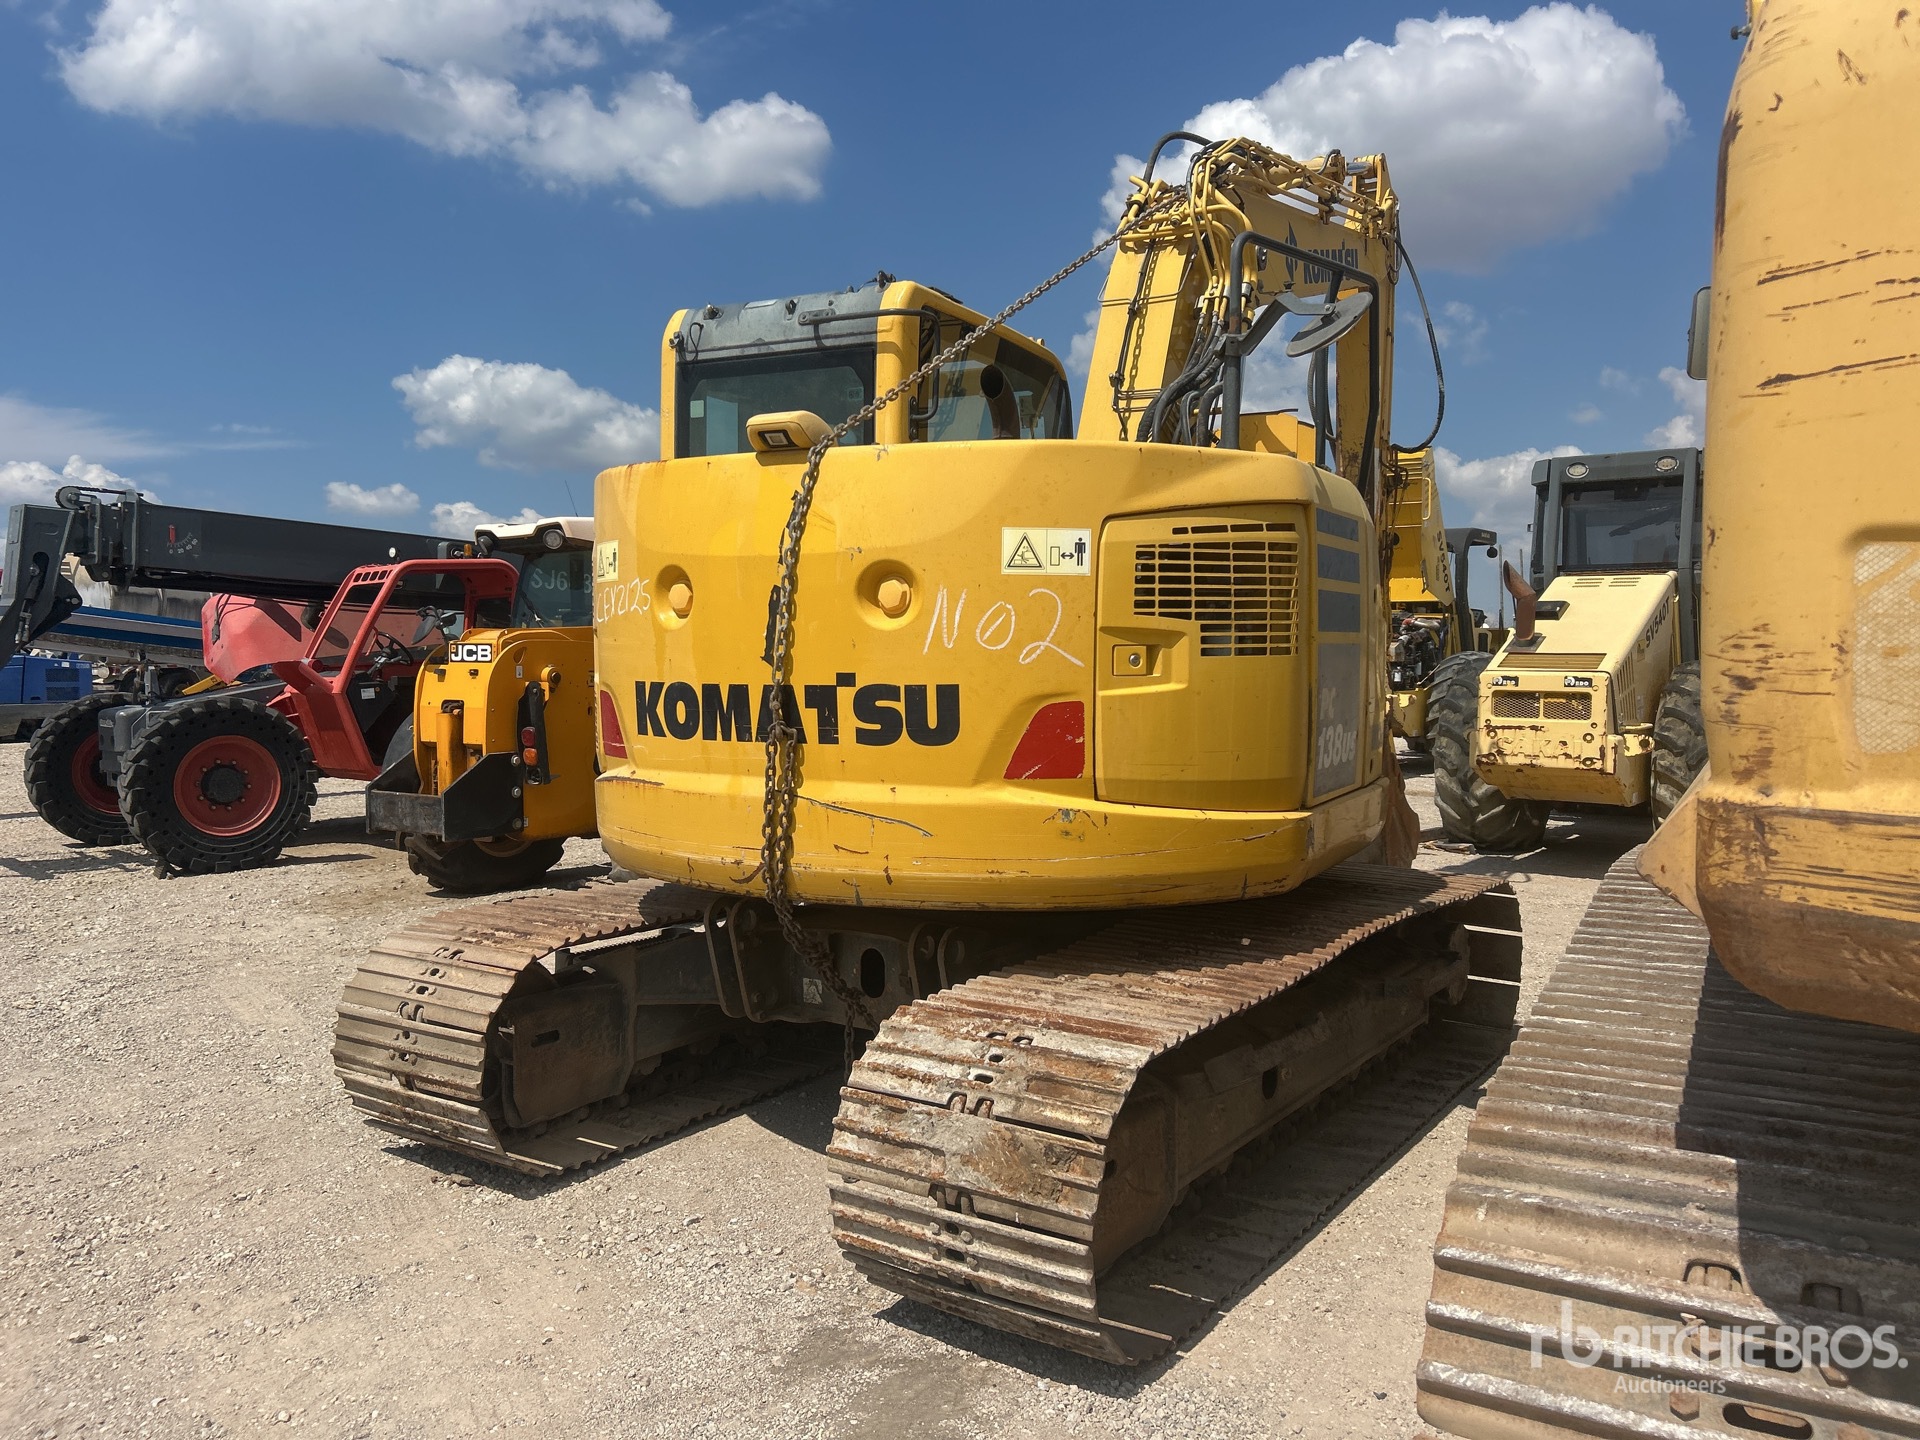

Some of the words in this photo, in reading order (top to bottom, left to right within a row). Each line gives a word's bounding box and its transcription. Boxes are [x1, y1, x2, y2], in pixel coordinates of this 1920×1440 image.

[1645, 595, 1670, 649] SV540T
[450, 644, 492, 662] JCB
[634, 672, 961, 747] KOMATSU
